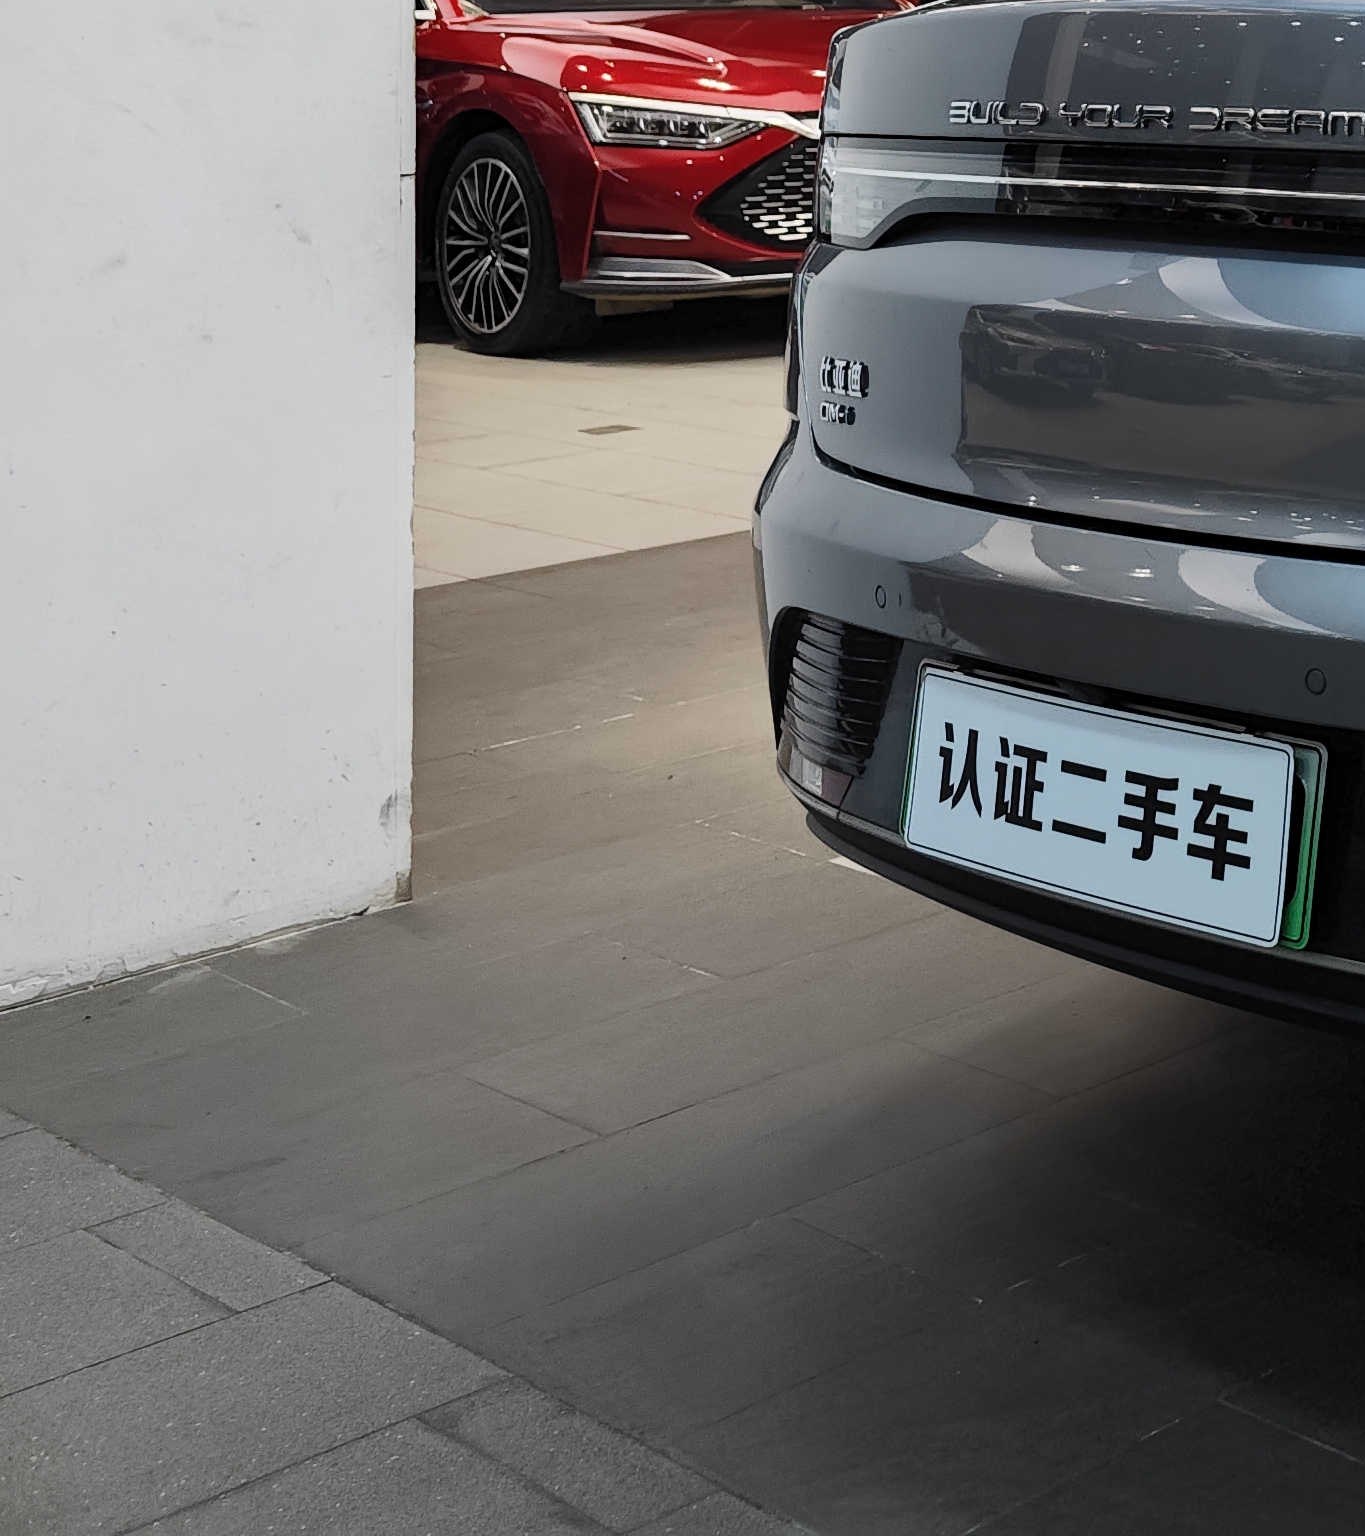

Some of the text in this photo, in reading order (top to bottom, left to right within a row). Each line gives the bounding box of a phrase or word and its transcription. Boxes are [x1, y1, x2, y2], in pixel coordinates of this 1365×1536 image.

[949, 100, 1045, 127] BUILD
[1058, 101, 1174, 129] YOUR
[938, 721, 1255, 882] 认证二手车
